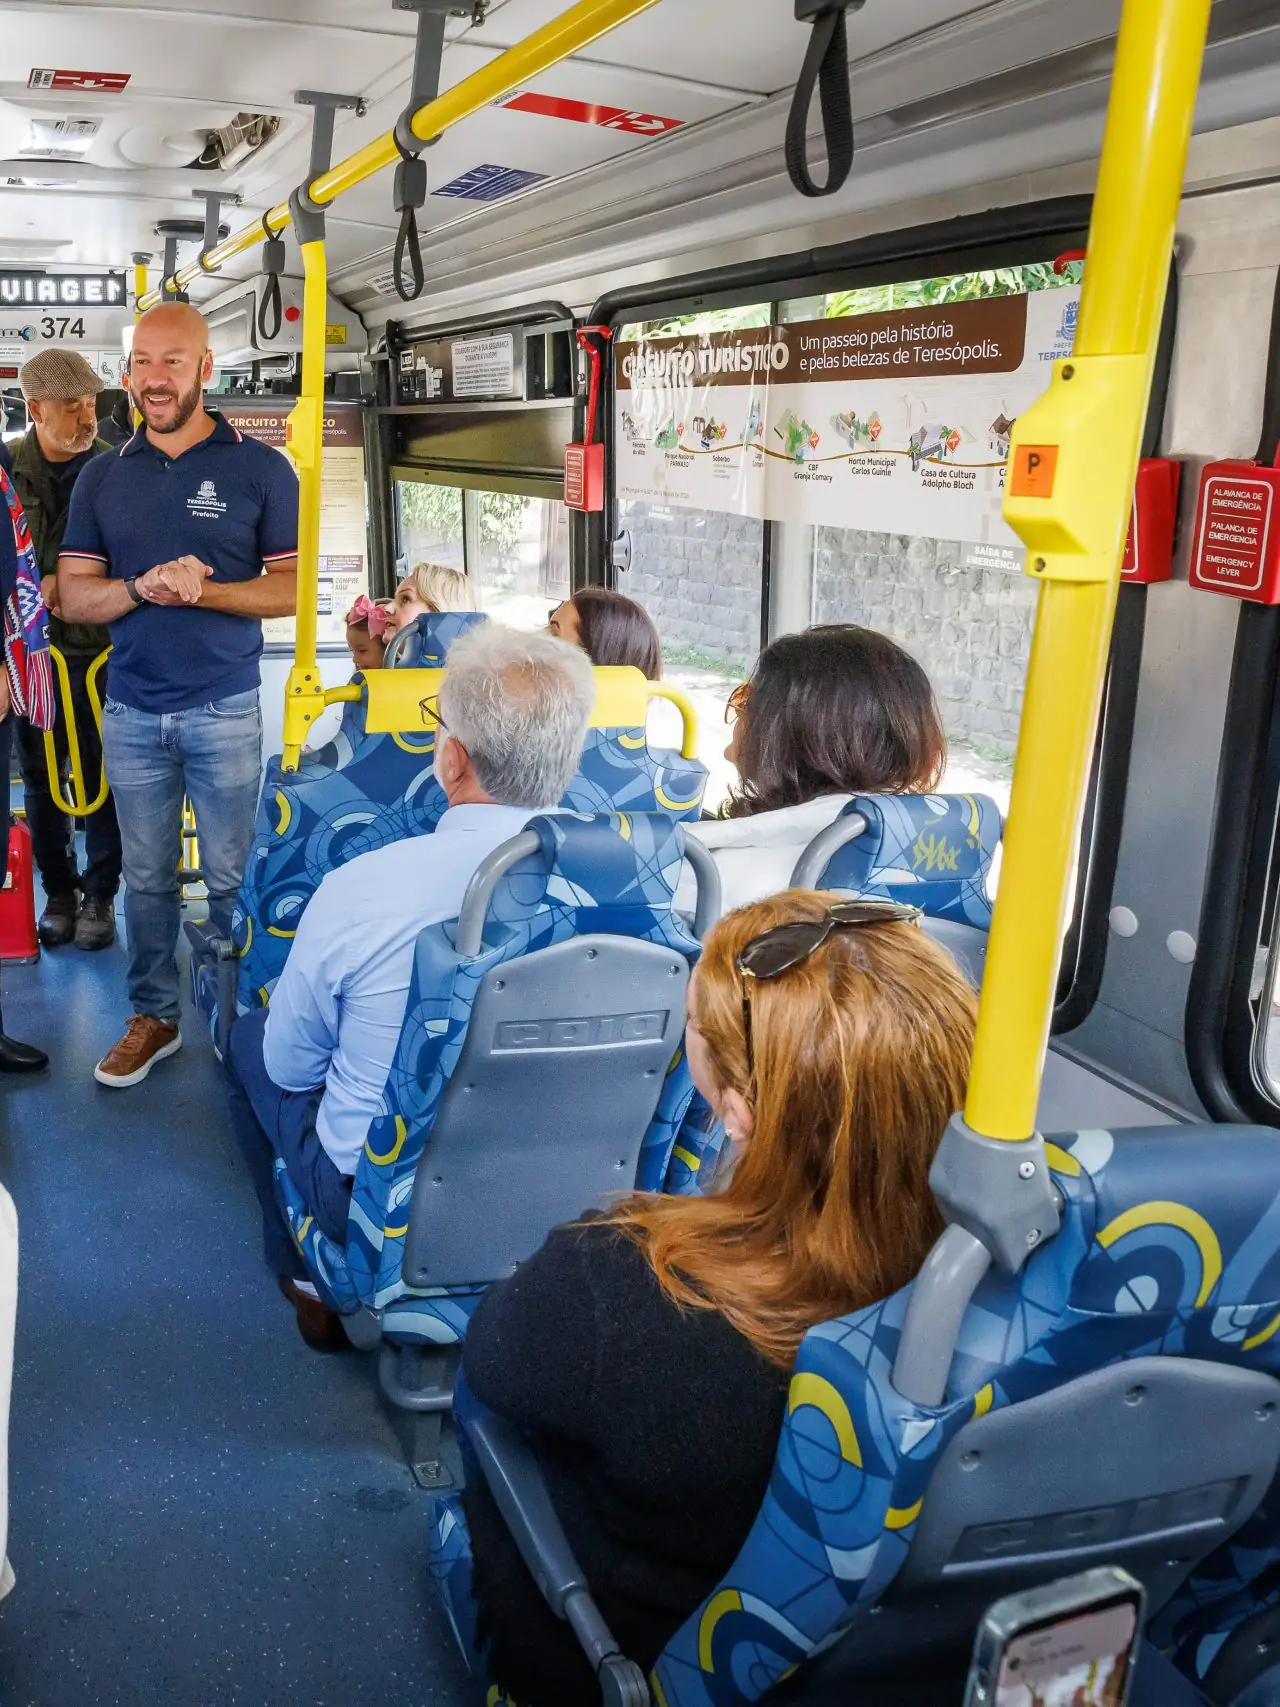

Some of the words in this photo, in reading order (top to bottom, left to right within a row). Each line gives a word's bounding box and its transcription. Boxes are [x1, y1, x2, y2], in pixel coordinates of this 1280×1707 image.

[41, 317, 86, 339] 374
[800, 336, 820, 350] Um
[822, 329, 868, 352] passeio
[870, 326, 898, 349] pela
[901, 320, 954, 342] história
[622, 349, 696, 379] CIRCUITO
[699, 340, 790, 373] TURÍSTICO
[800, 357, 807, 371] e
[809, 353, 840, 374] pelas
[842, 350, 890, 367] belezas
[892, 348, 910, 363] de
[913, 338, 1002, 365] Teresópolis.
[228, 418, 278, 427] CIRCUITO
[867, 458, 897, 467] Municipal
[794, 472, 811, 481] Granja
[812, 472, 833, 483] Comary
[851, 467, 870, 475] Carlos
[871, 468, 892, 476] Guinle
[921, 469, 937, 478] Casa
[939, 469, 947, 477] de
[949, 470, 976, 479] Cultura
[922, 479, 951, 490] Adolpho
[953, 480, 974, 490] Bloch
[1213, 488, 1251, 500] ALAVANCA
[1252, 492, 1263, 500] DE
[187, 498, 227, 507] TERESÓPOLIS
[1211, 498, 1262, 512] EMERGÊNCIA
[192, 510, 219, 518] Prefeito
[1211, 521, 1245, 533] PALANCA
[1208, 531, 1257, 545] EMERGENCIA
[974, 544, 1000, 557] SAÍDA
[1002, 547, 1015, 559] DE
[966, 555, 1022, 571] EMERGÊNCIA
[1205, 554, 1255, 569] EMERGENCY
[1217, 566, 1240, 577] LEVER
